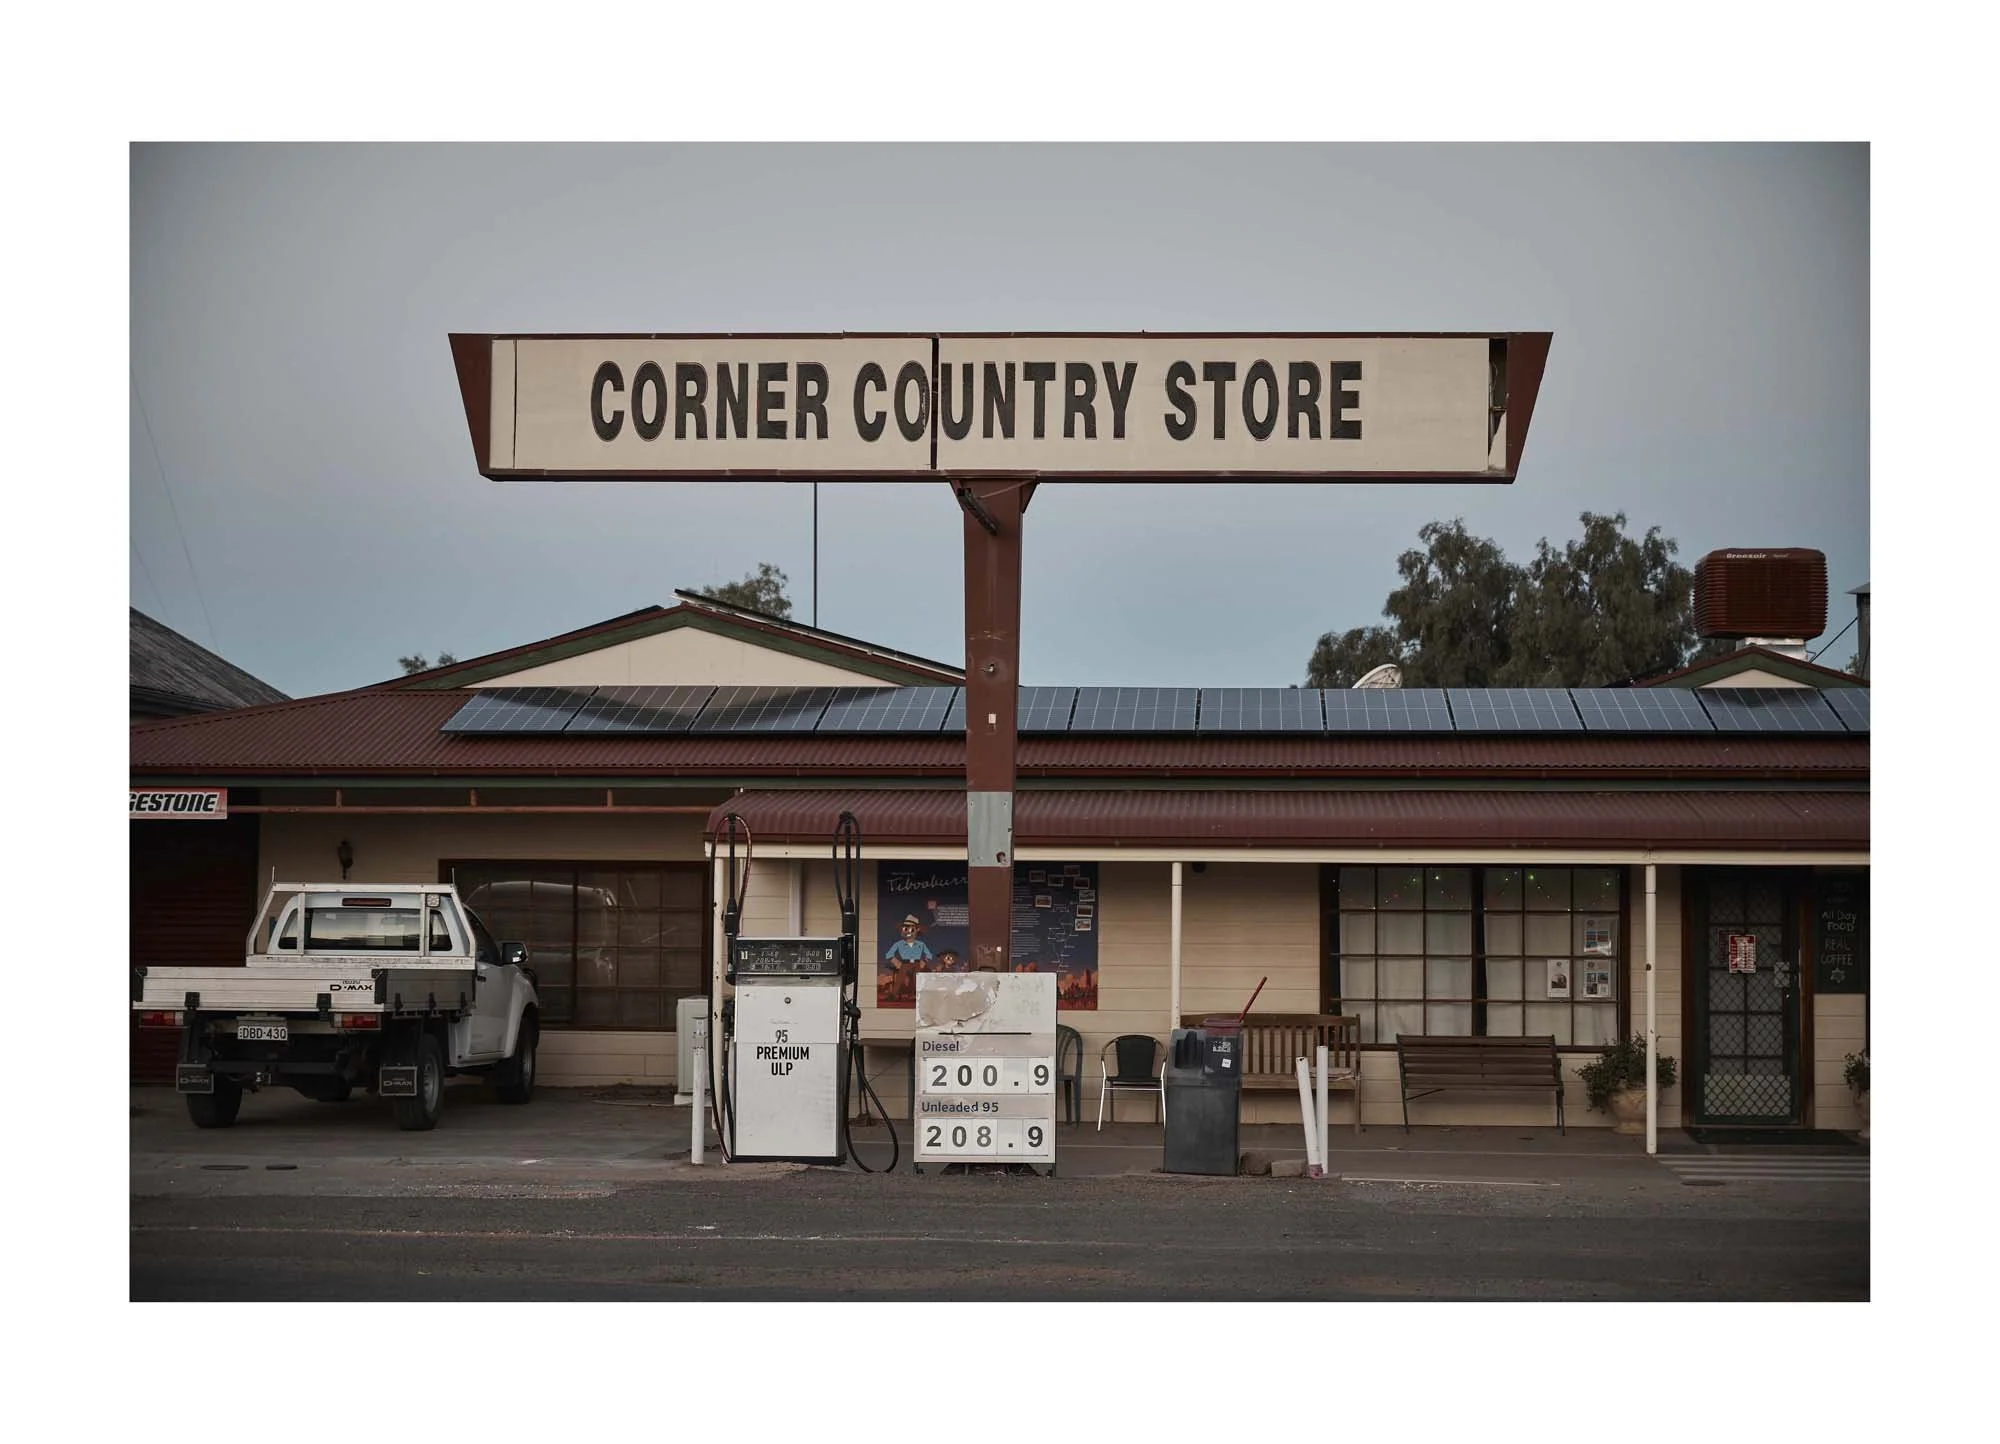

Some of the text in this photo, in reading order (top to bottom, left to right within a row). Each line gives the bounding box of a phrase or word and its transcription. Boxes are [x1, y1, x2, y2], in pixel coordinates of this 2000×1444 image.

[591, 359, 1363, 442] CORNER COUNTRY STORE
[1837, 910, 1857, 924] Day
[826, 949, 832, 959] 2
[1820, 954, 1854, 966] COFFEE
[775, 1030, 788, 1043] 95
[756, 1046, 809, 1060] PREMIUM
[922, 1041, 960, 1052] Diesel
[771, 1062, 793, 1075] ULP
[932, 1065, 1049, 1087] 200.9
[921, 1102, 999, 1113] Unleaded 95
[926, 1125, 1043, 1148] 208.9
